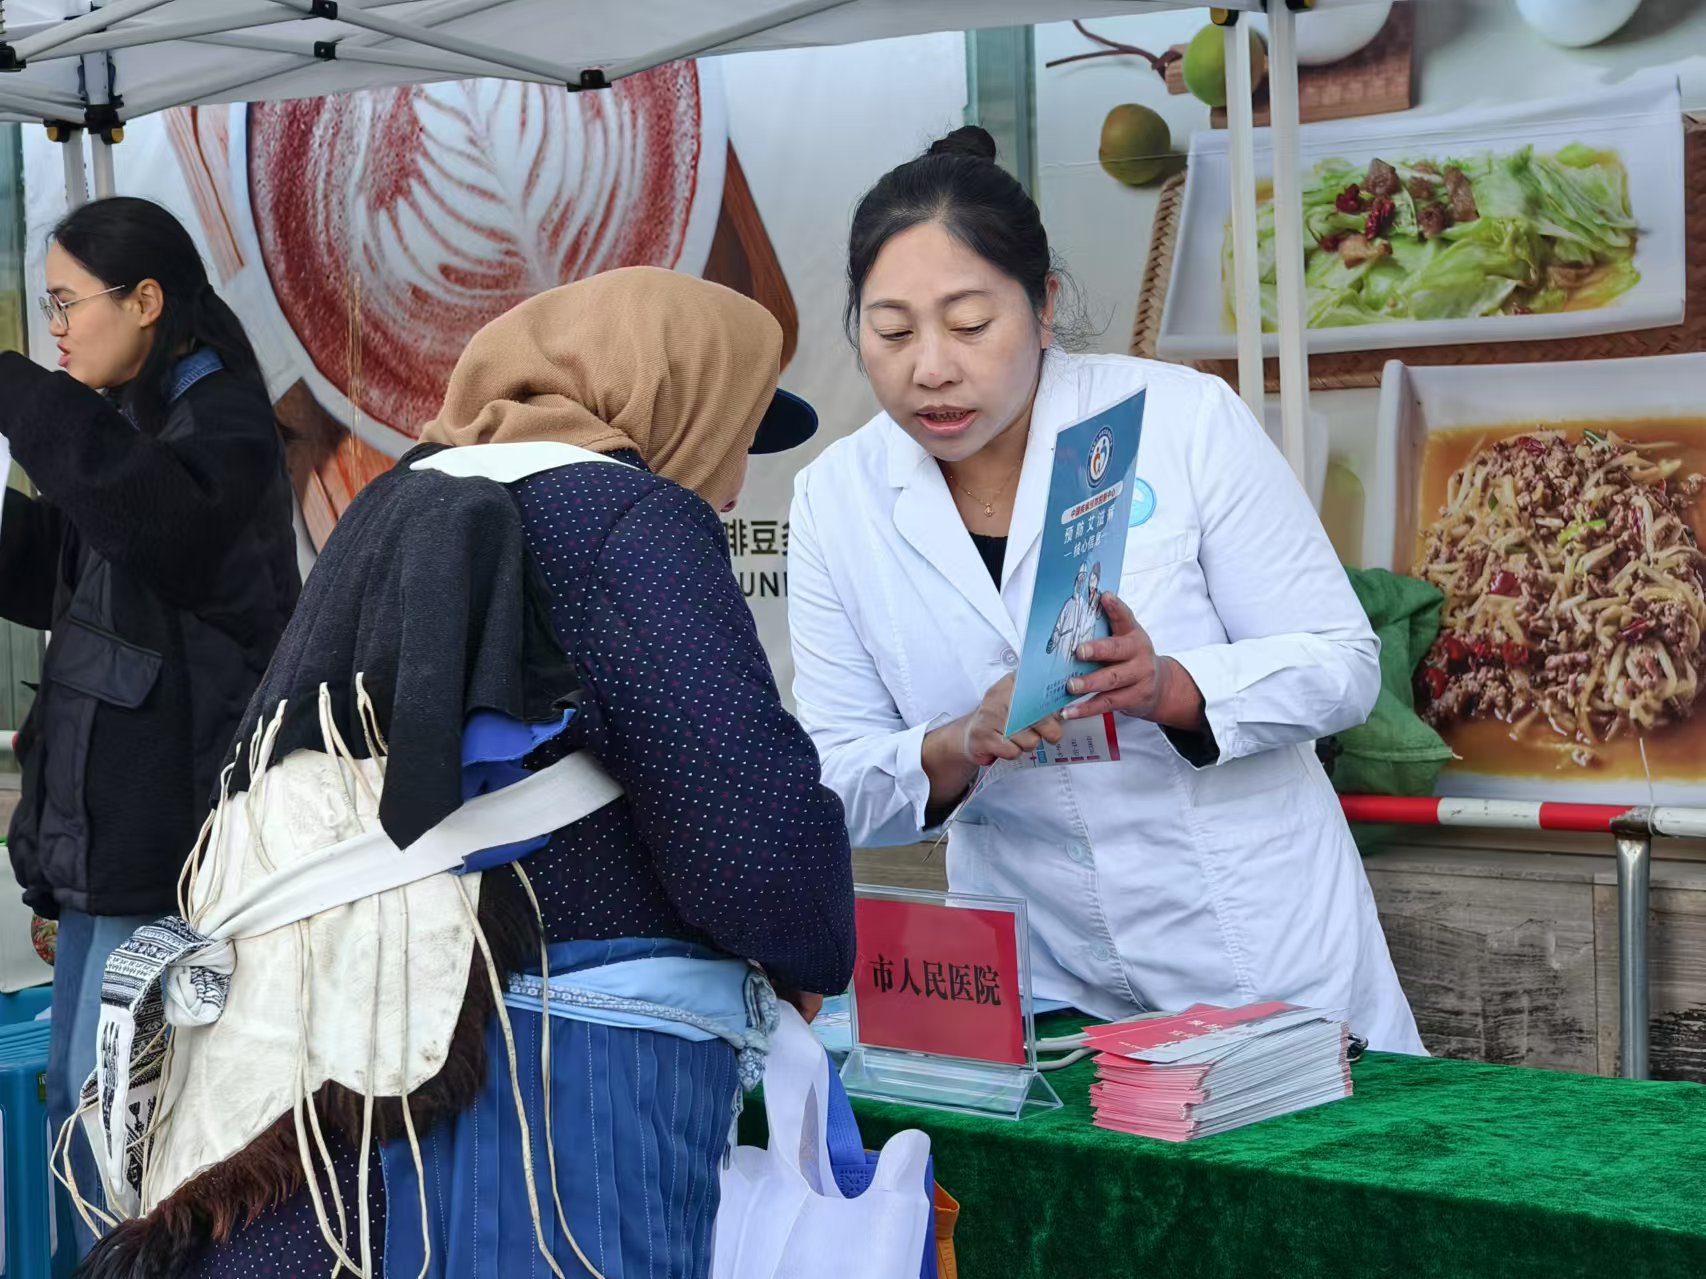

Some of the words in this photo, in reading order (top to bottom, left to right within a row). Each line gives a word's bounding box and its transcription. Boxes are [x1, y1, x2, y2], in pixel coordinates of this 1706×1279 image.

[724, 519, 789, 556] 啡豆
[870, 954, 1001, 1006] 市人民医院
